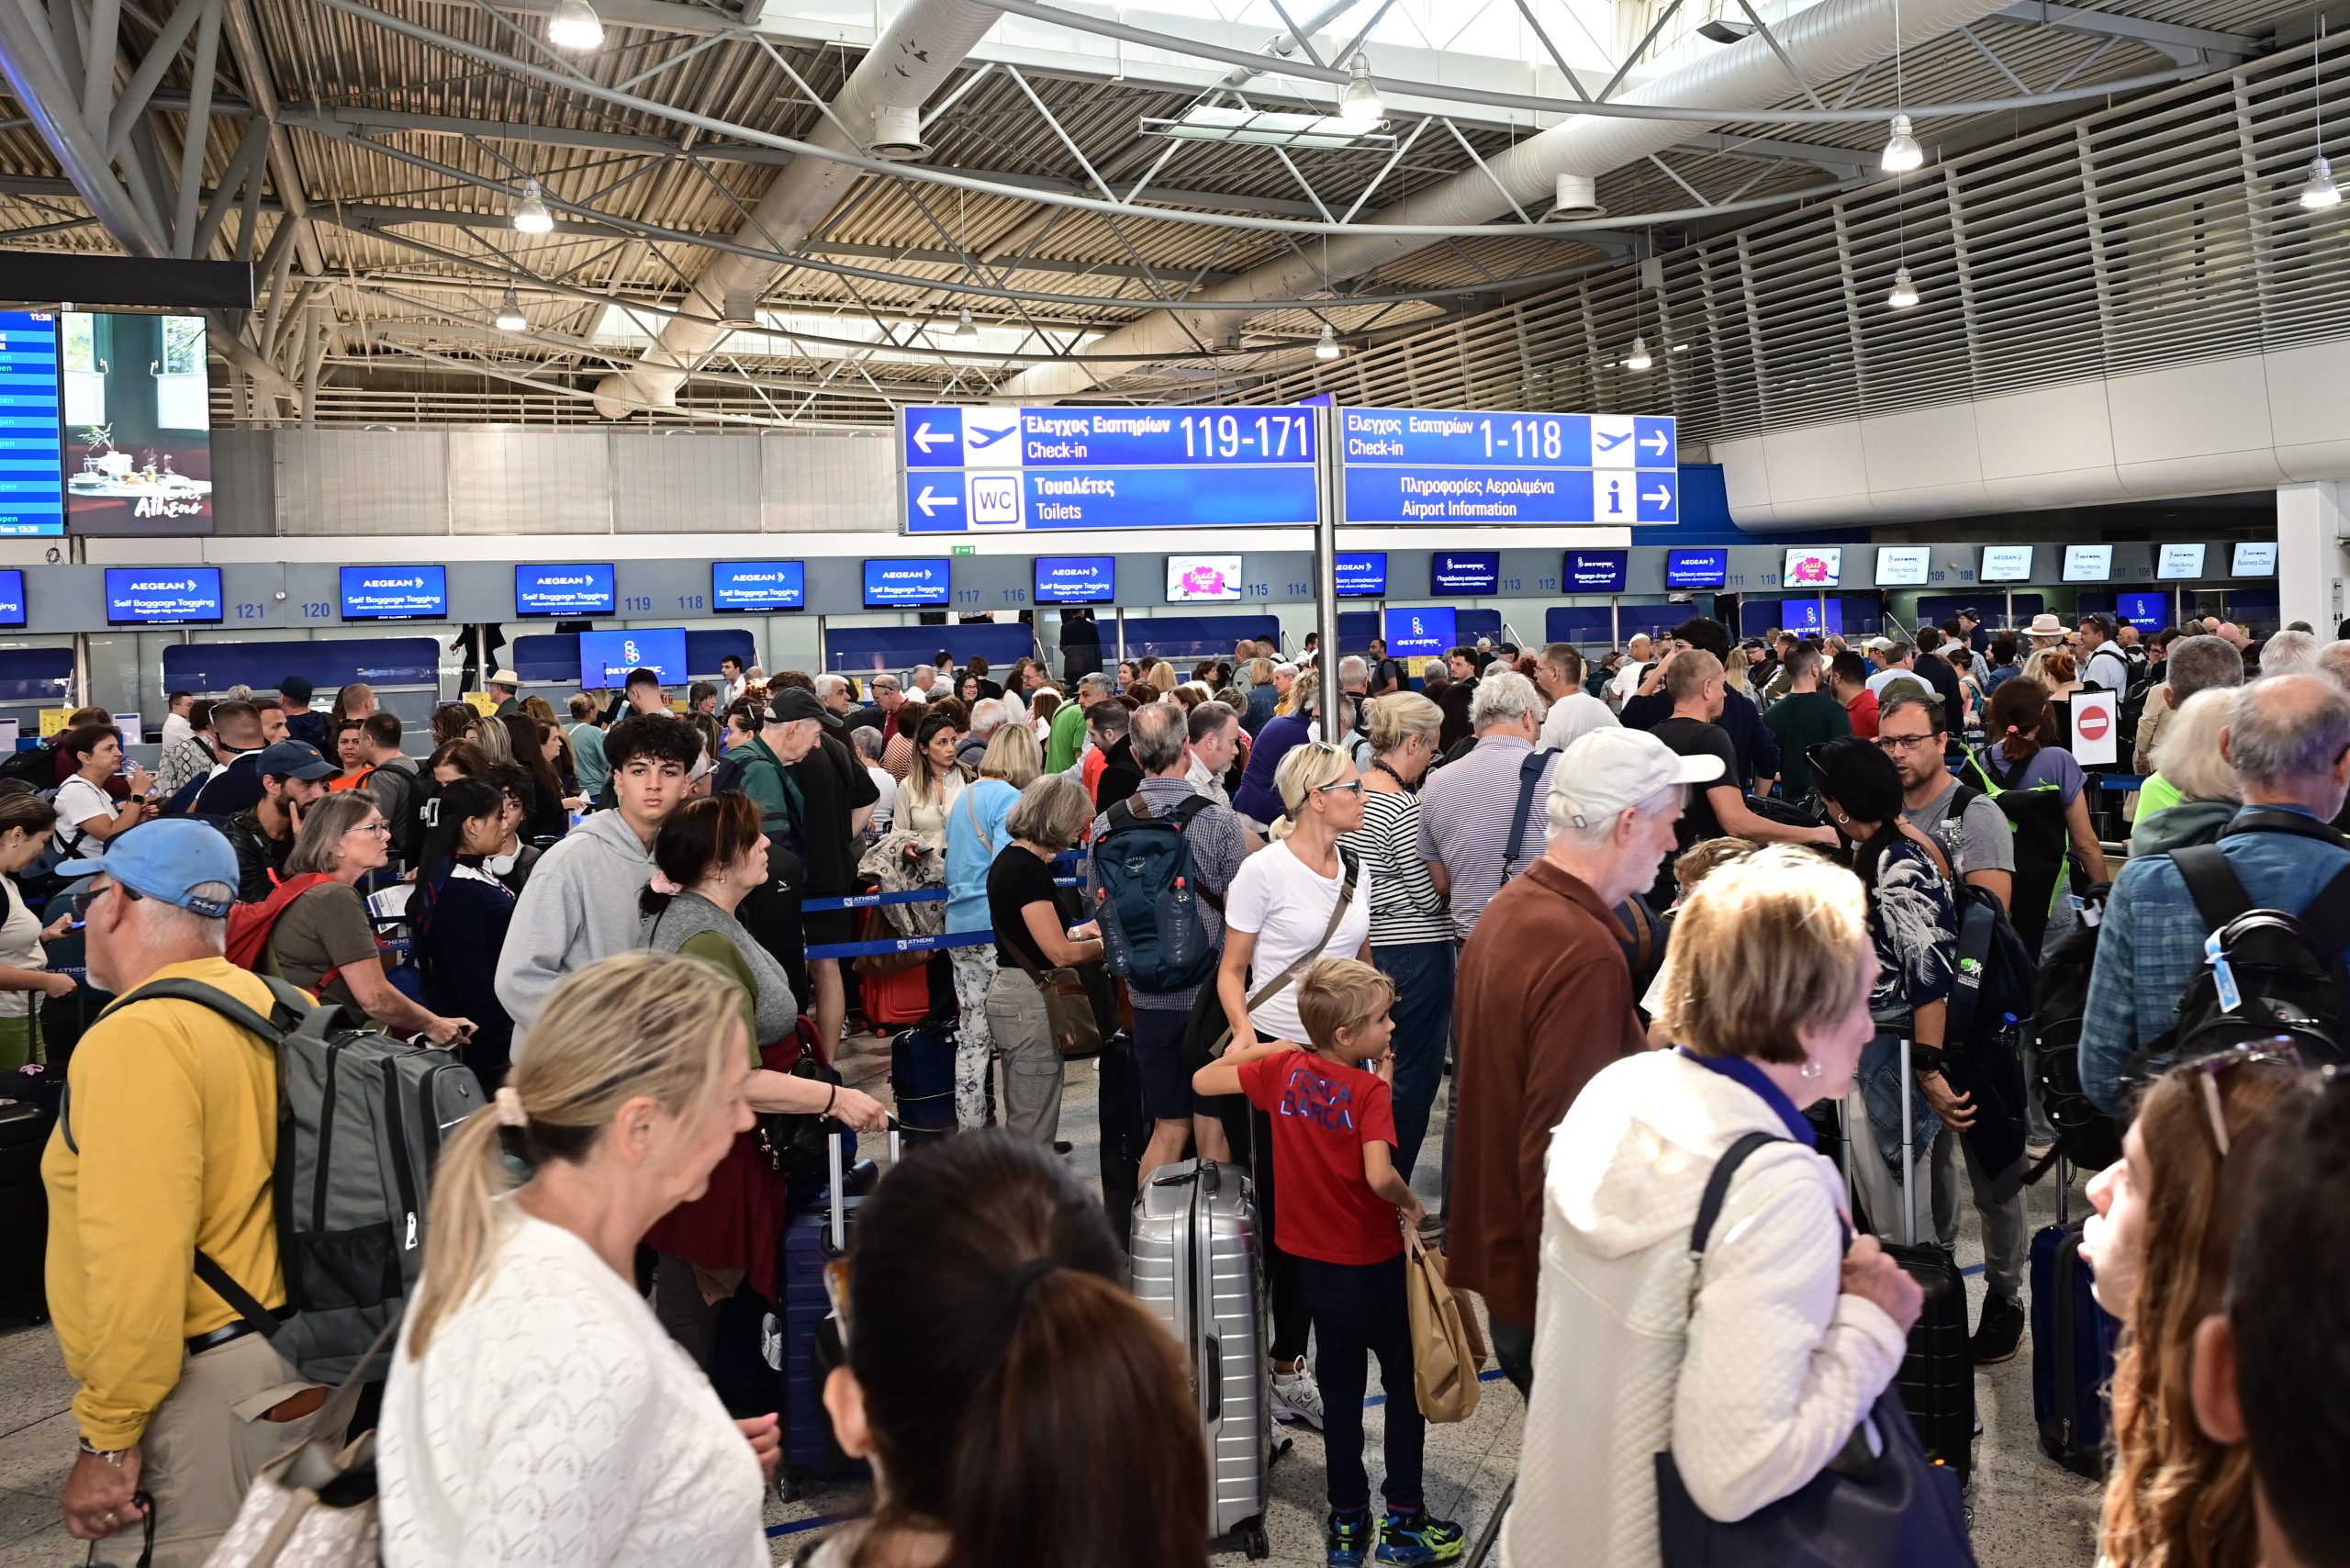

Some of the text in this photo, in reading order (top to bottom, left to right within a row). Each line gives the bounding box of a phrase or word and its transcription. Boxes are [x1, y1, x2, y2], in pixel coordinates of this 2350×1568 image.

[29, 313, 52, 321] 11:38
[1021, 416, 1171, 437] Έλεγχος Εισιτηρίων
[1348, 415, 1402, 436] Ελεγχος
[1180, 416, 1307, 458] 119-171
[1480, 419, 1561, 459] 1-118
[1028, 442, 1088, 459] Check-in
[1348, 439, 1404, 456] Check-in
[1035, 476, 1115, 497] Τουαλέτες
[1401, 477, 1555, 497] Πληροφορίες Αερολιμένα
[979, 491, 1012, 510] WC
[1036, 503, 1082, 521] Toilets
[1402, 500, 1517, 520] Airport Information
[1931, 571, 1945, 581] 109
[1960, 570, 1974, 581] 108
[2114, 568, 2126, 577] 107
[2138, 567, 2150, 577] 106
[1503, 579, 1521, 590] 113
[1538, 579, 1556, 589] 112
[1729, 575, 1744, 585] 111
[1761, 574, 1776, 585] 110
[130, 582, 185, 590] AEGEAN
[1248, 584, 1268, 596] 115
[1287, 583, 1307, 595] 114
[366, 596, 405, 605] Baggage
[406, 595, 441, 604] Tagging
[539, 593, 576, 602] Baggage
[576, 593, 609, 601] Tagging
[957, 590, 980, 602] 117
[1003, 589, 1025, 602] 116
[114, 599, 216, 608] Self Baggage Tagging
[625, 597, 651, 611] 119
[677, 596, 703, 610] 118
[236, 604, 264, 619] 121
[302, 603, 330, 618] 120
